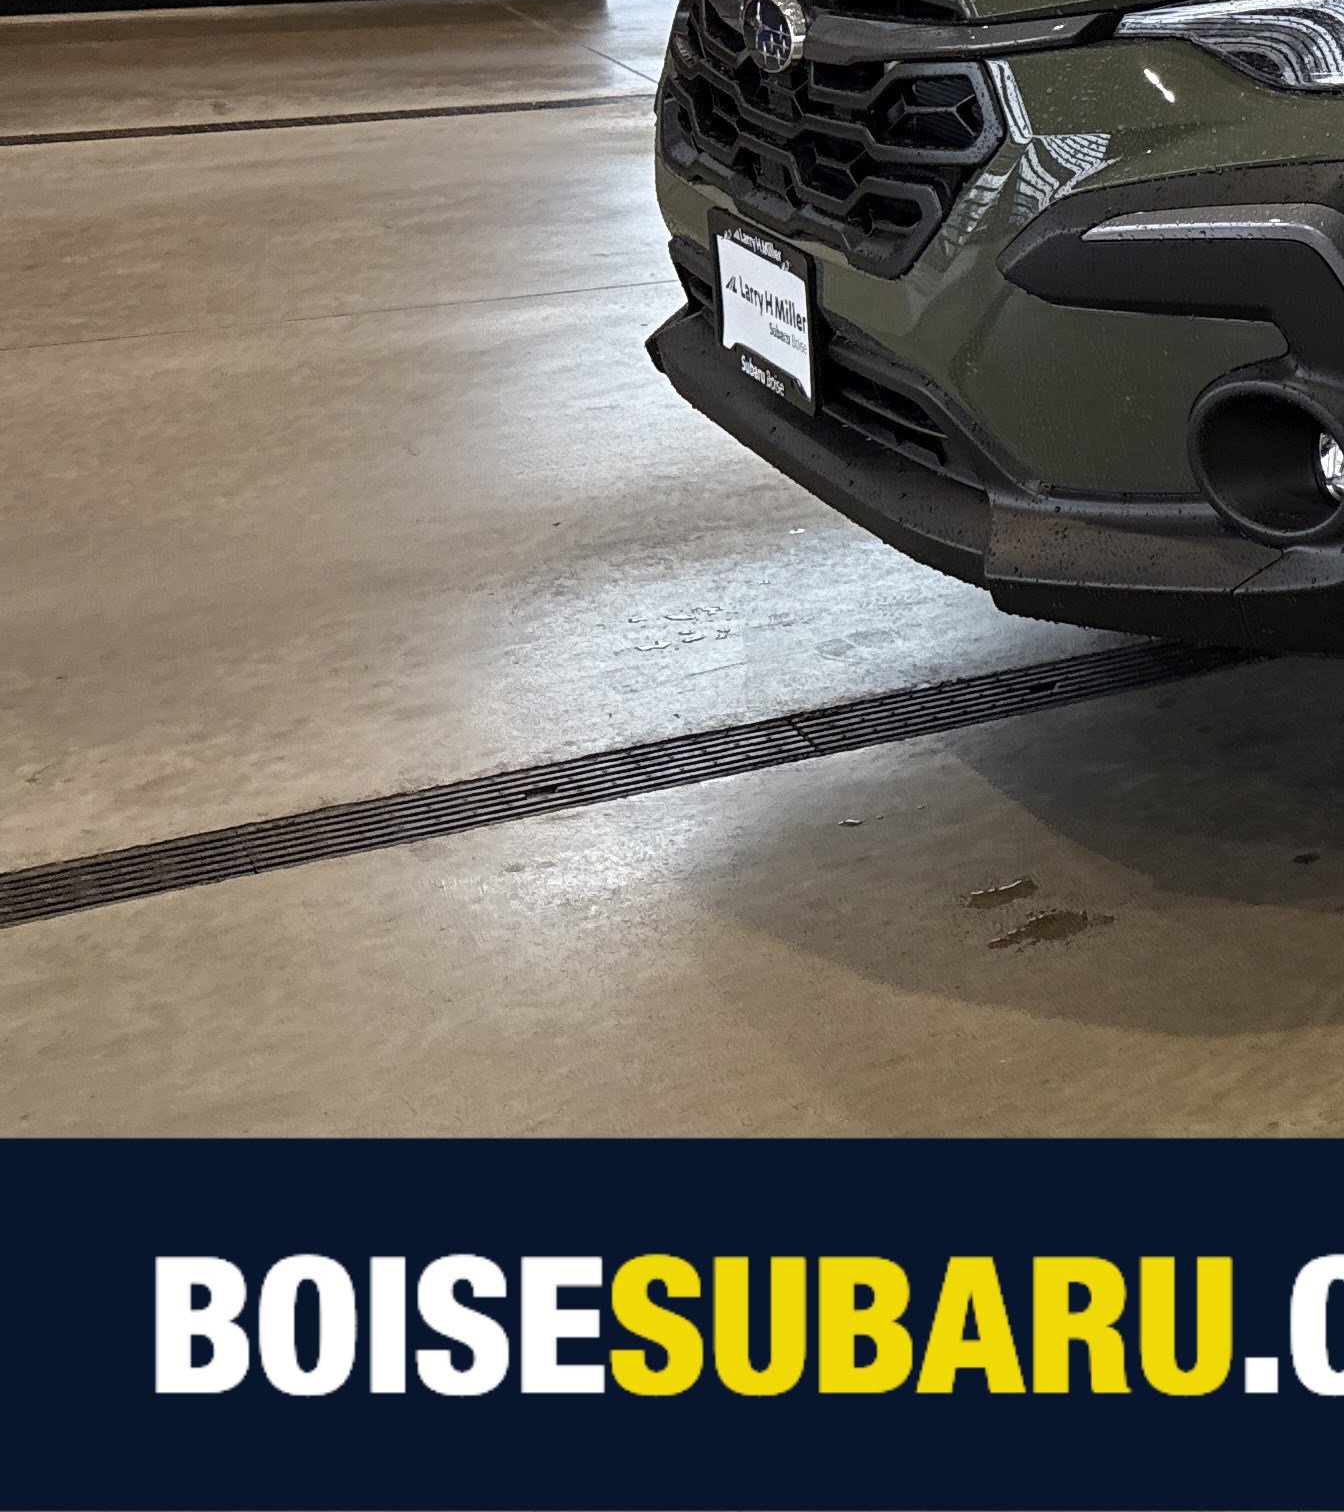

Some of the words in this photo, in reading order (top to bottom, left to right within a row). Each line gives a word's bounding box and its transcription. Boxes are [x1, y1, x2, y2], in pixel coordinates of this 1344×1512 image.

[738, 275, 763, 316] Larry
[764, 290, 773, 317] H
[774, 295, 807, 334] Miller
